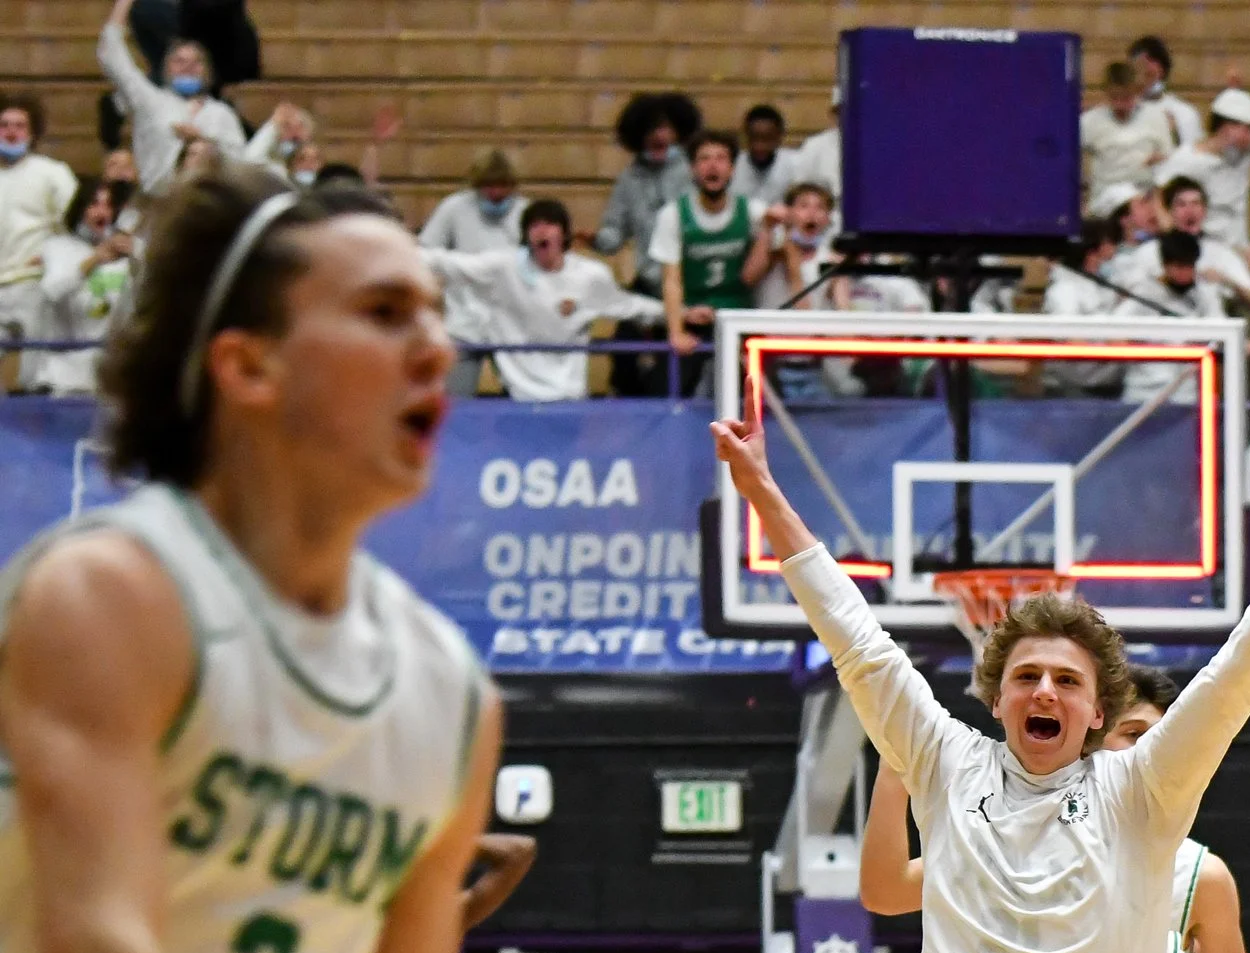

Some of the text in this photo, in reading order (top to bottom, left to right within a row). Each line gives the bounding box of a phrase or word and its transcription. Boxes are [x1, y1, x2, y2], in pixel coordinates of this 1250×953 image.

[480, 458, 639, 508] OSAA
[483, 531, 702, 578] ONPOIN
[487, 580, 697, 620] CREDIT
[493, 629, 668, 656] STATE
[679, 785, 728, 824] EXIT
[168, 751, 430, 920] STORM
